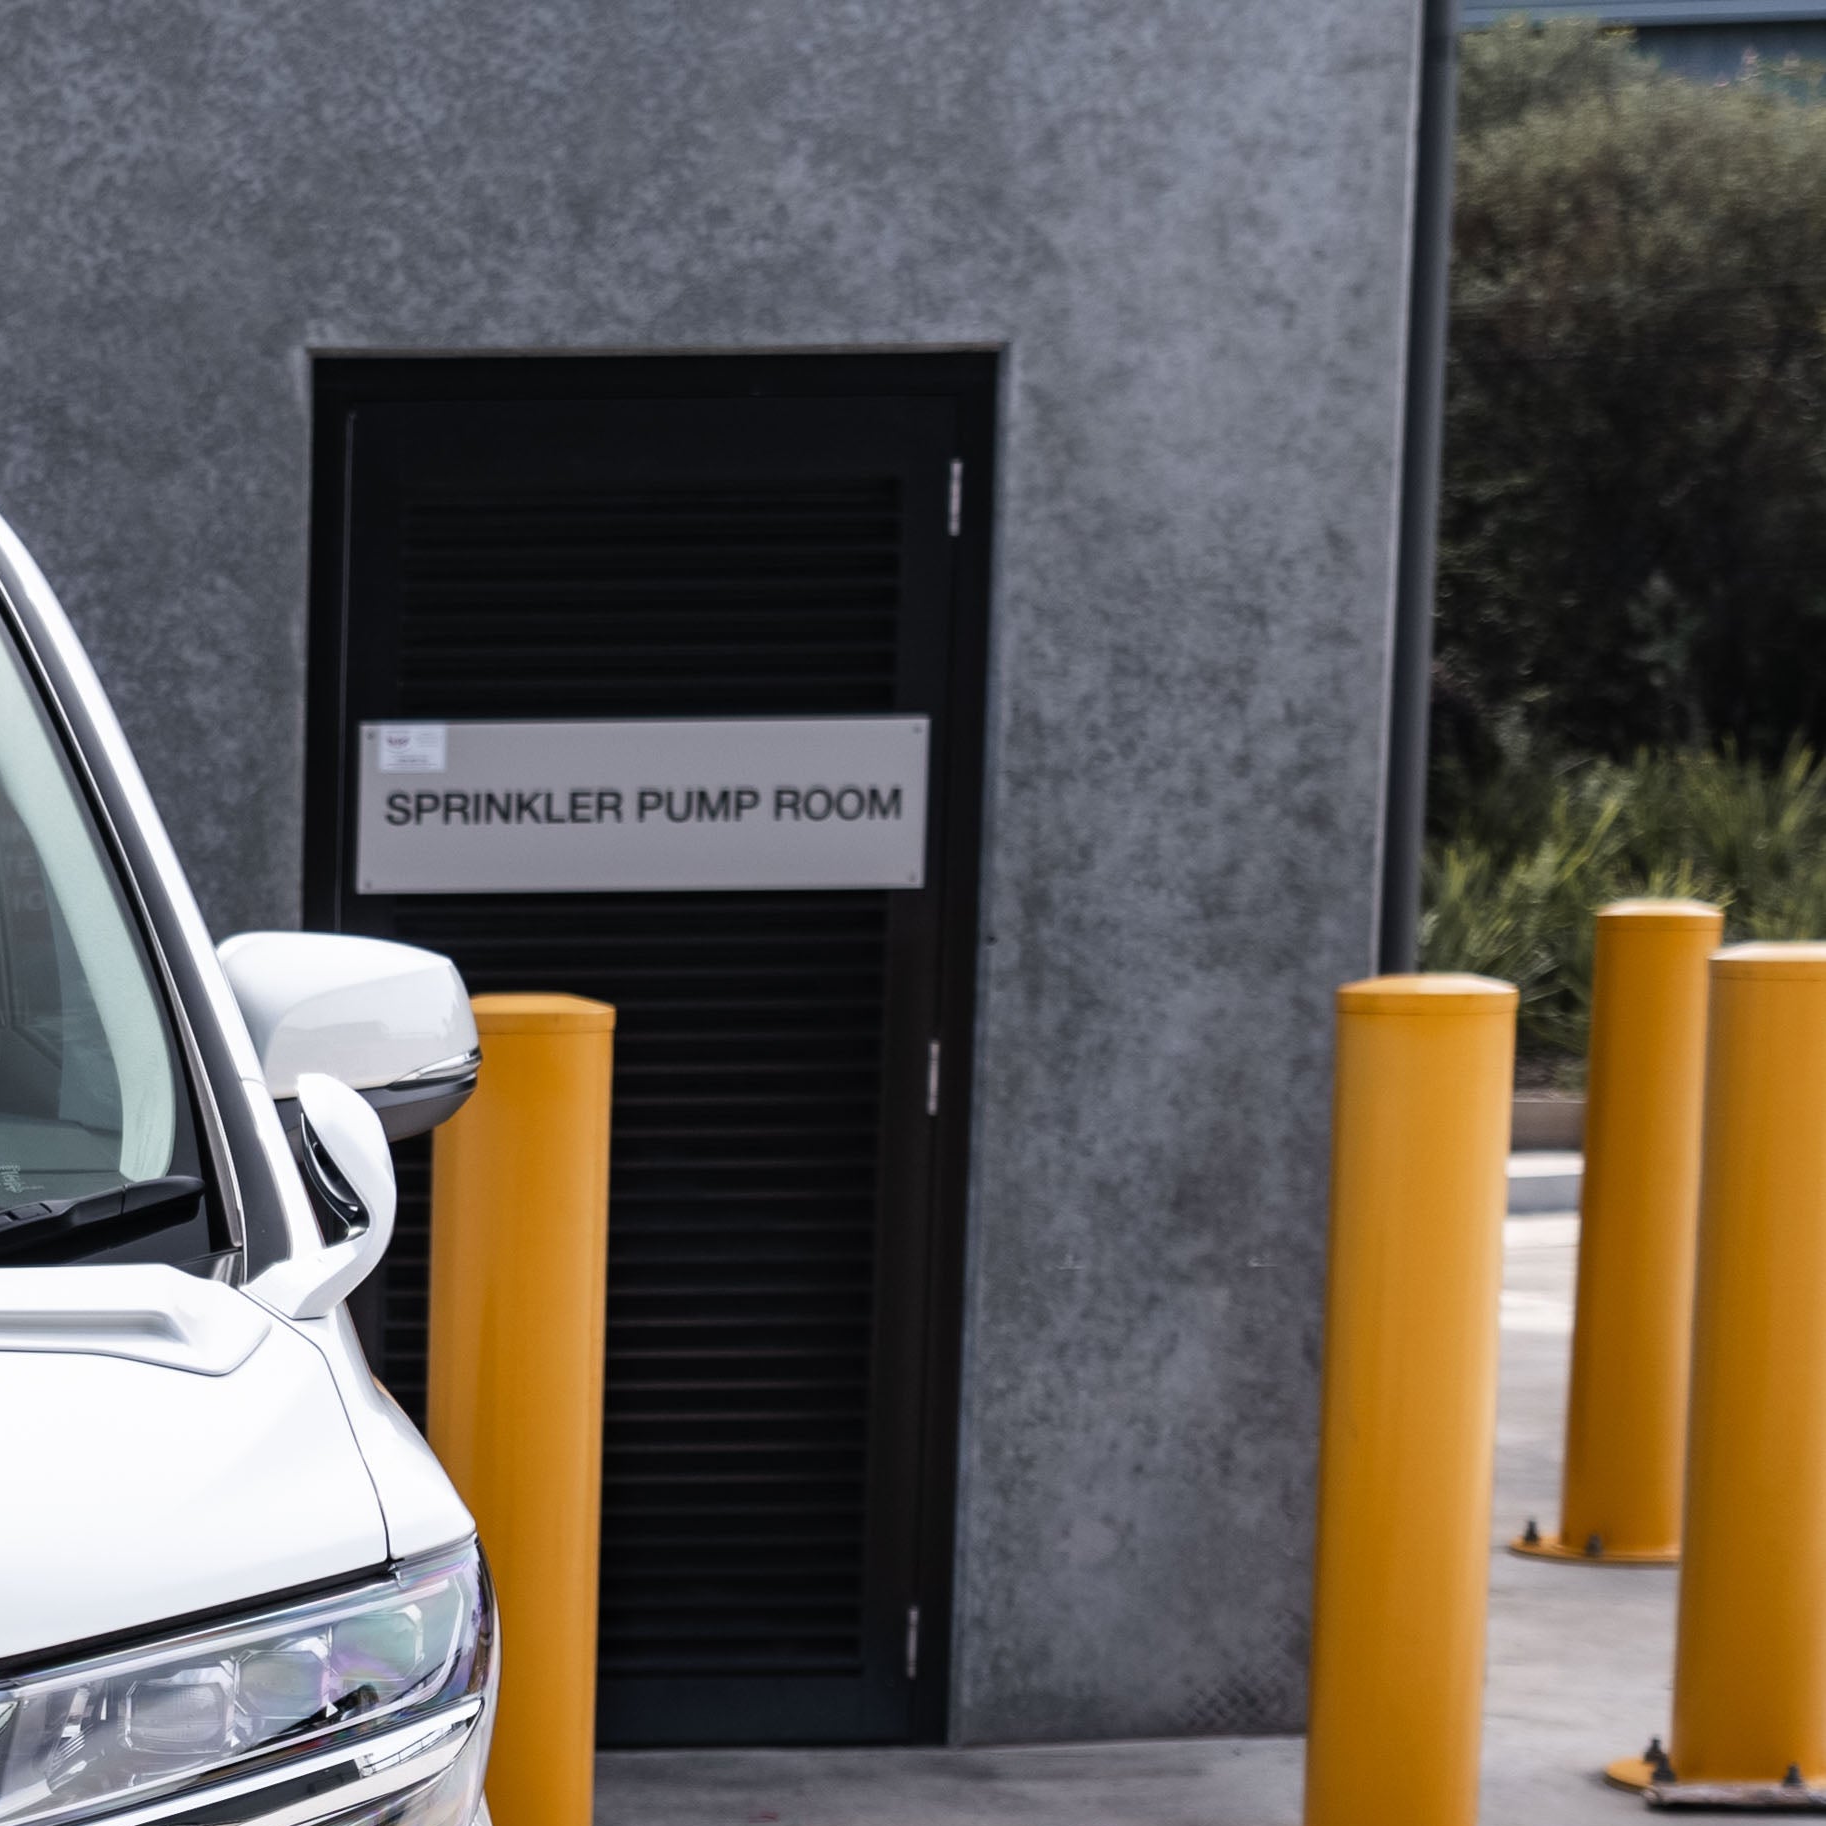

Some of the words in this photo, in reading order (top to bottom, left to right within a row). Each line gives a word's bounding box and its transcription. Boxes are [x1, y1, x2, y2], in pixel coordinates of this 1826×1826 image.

[384, 787, 624, 827] SPRINKLER
[635, 785, 762, 825] PUMP
[772, 783, 903, 823] ROOM
